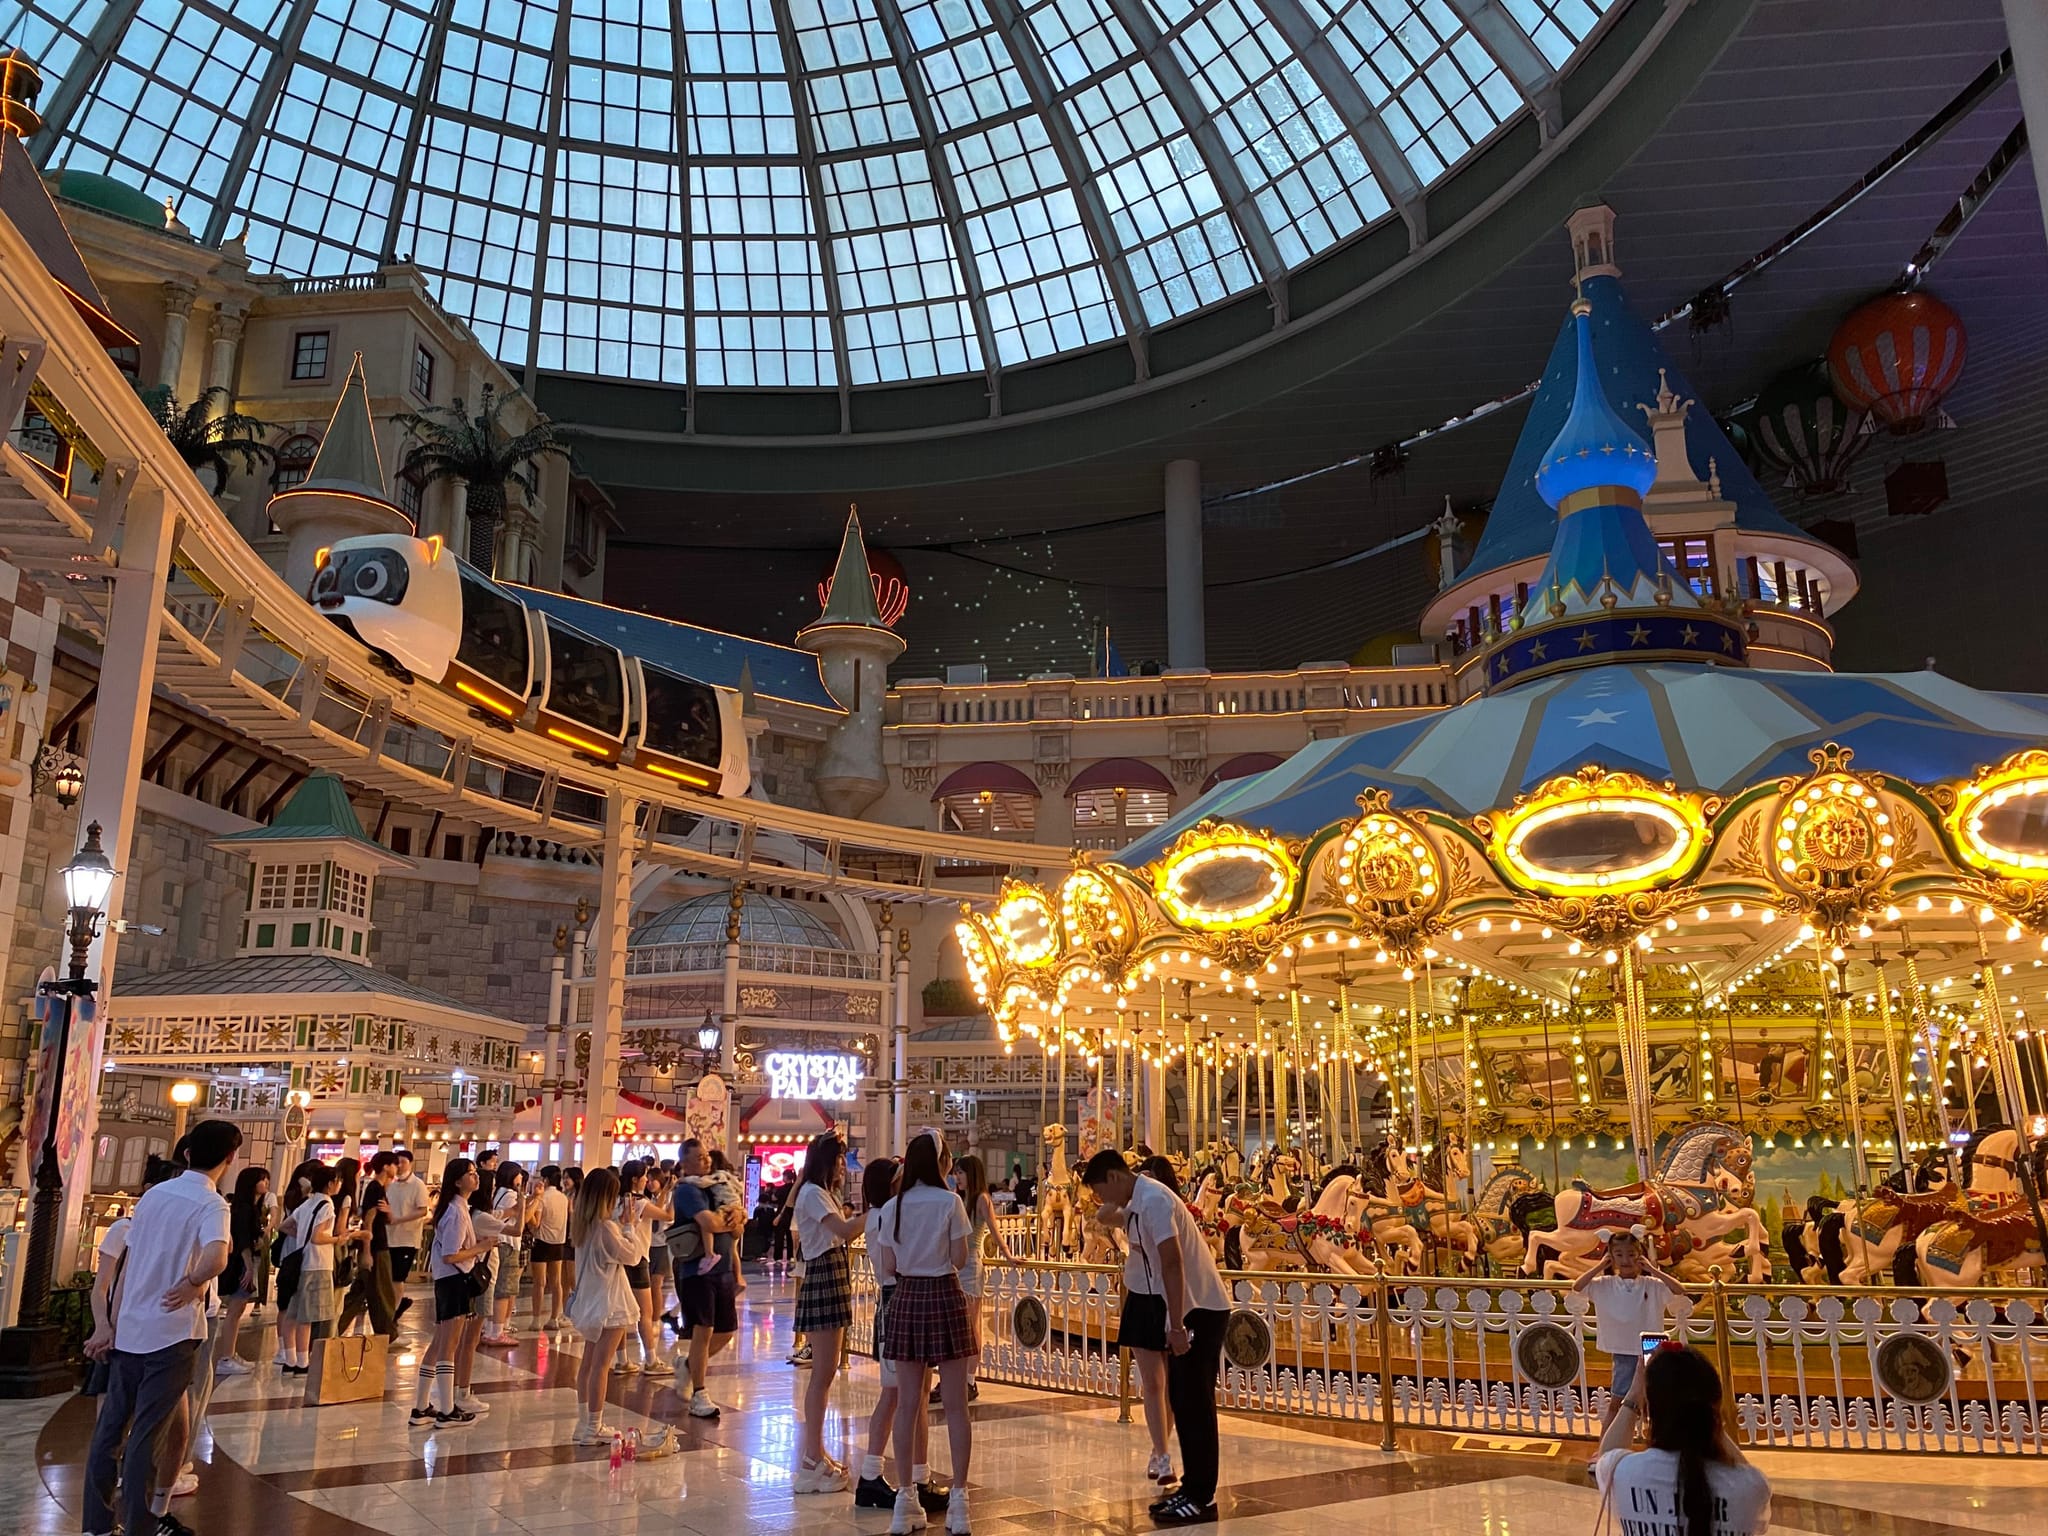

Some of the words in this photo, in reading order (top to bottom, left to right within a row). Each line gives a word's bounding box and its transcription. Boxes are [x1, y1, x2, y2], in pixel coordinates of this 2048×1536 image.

[765, 1053, 864, 1080] CRYSTAL
[771, 1075, 857, 1101] PALACE
[1630, 1486, 1658, 1515] UN
[1668, 1493, 1730, 1522] JR
